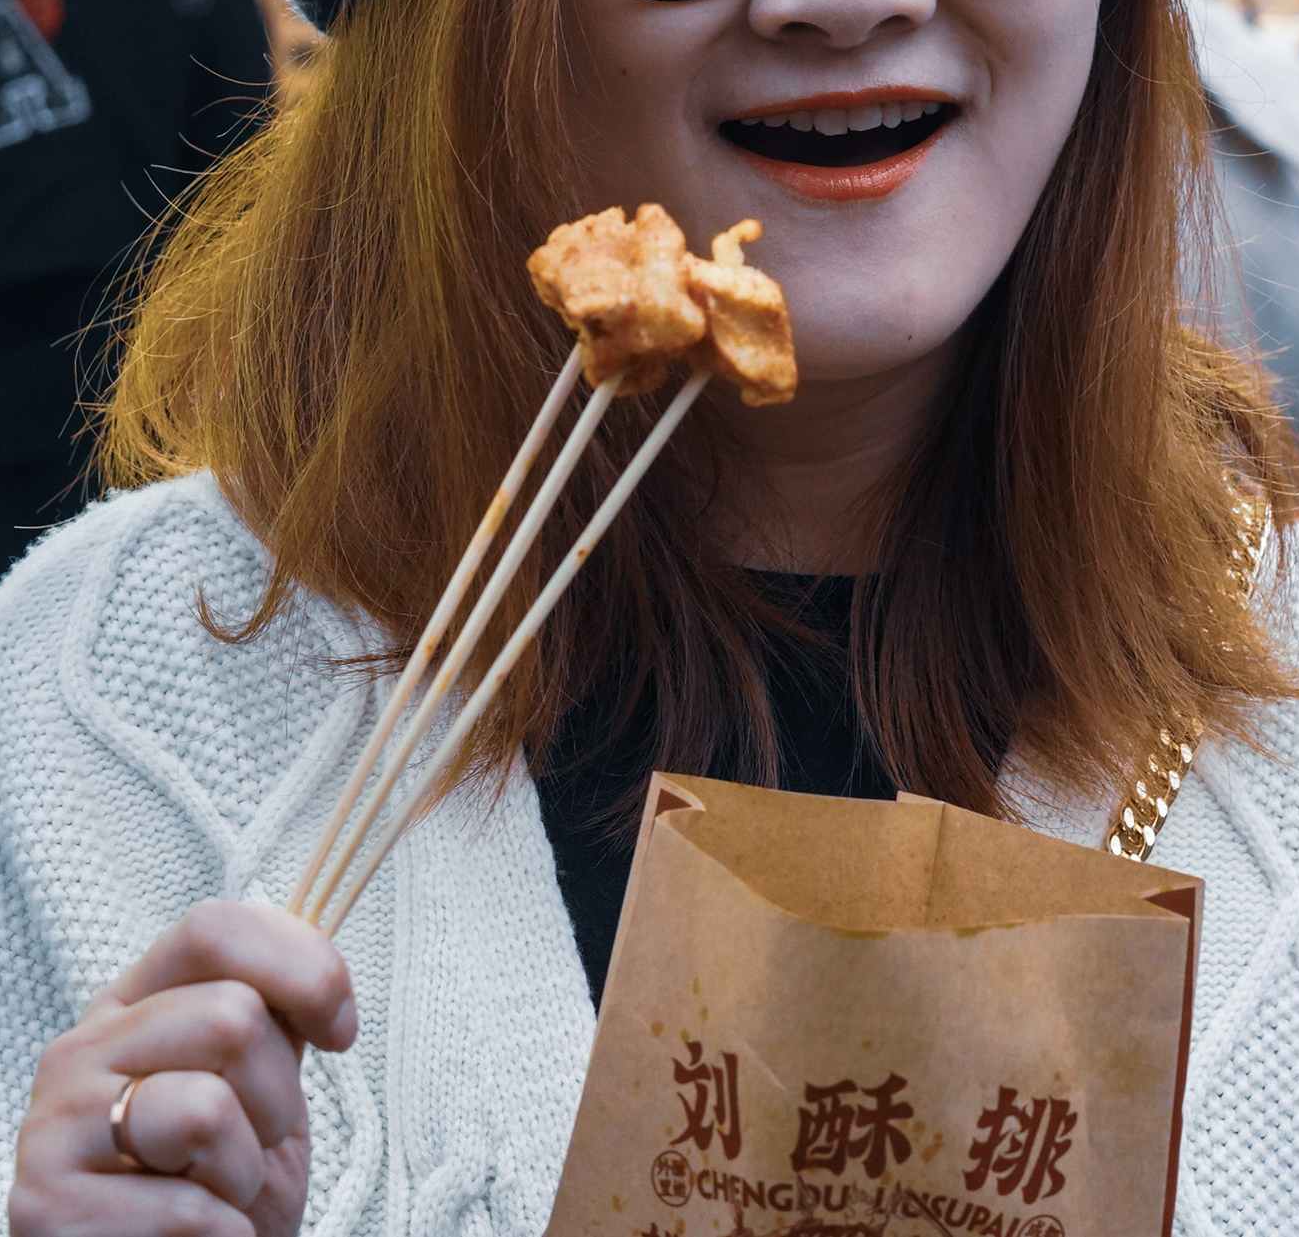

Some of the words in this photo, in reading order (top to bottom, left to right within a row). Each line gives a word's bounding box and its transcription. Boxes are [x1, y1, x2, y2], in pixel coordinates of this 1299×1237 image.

[672, 1041, 1079, 1205] 刘酥排
[697, 1168, 851, 1213] CHENGDU
[874, 1185, 1021, 1237] LUSUPAI
